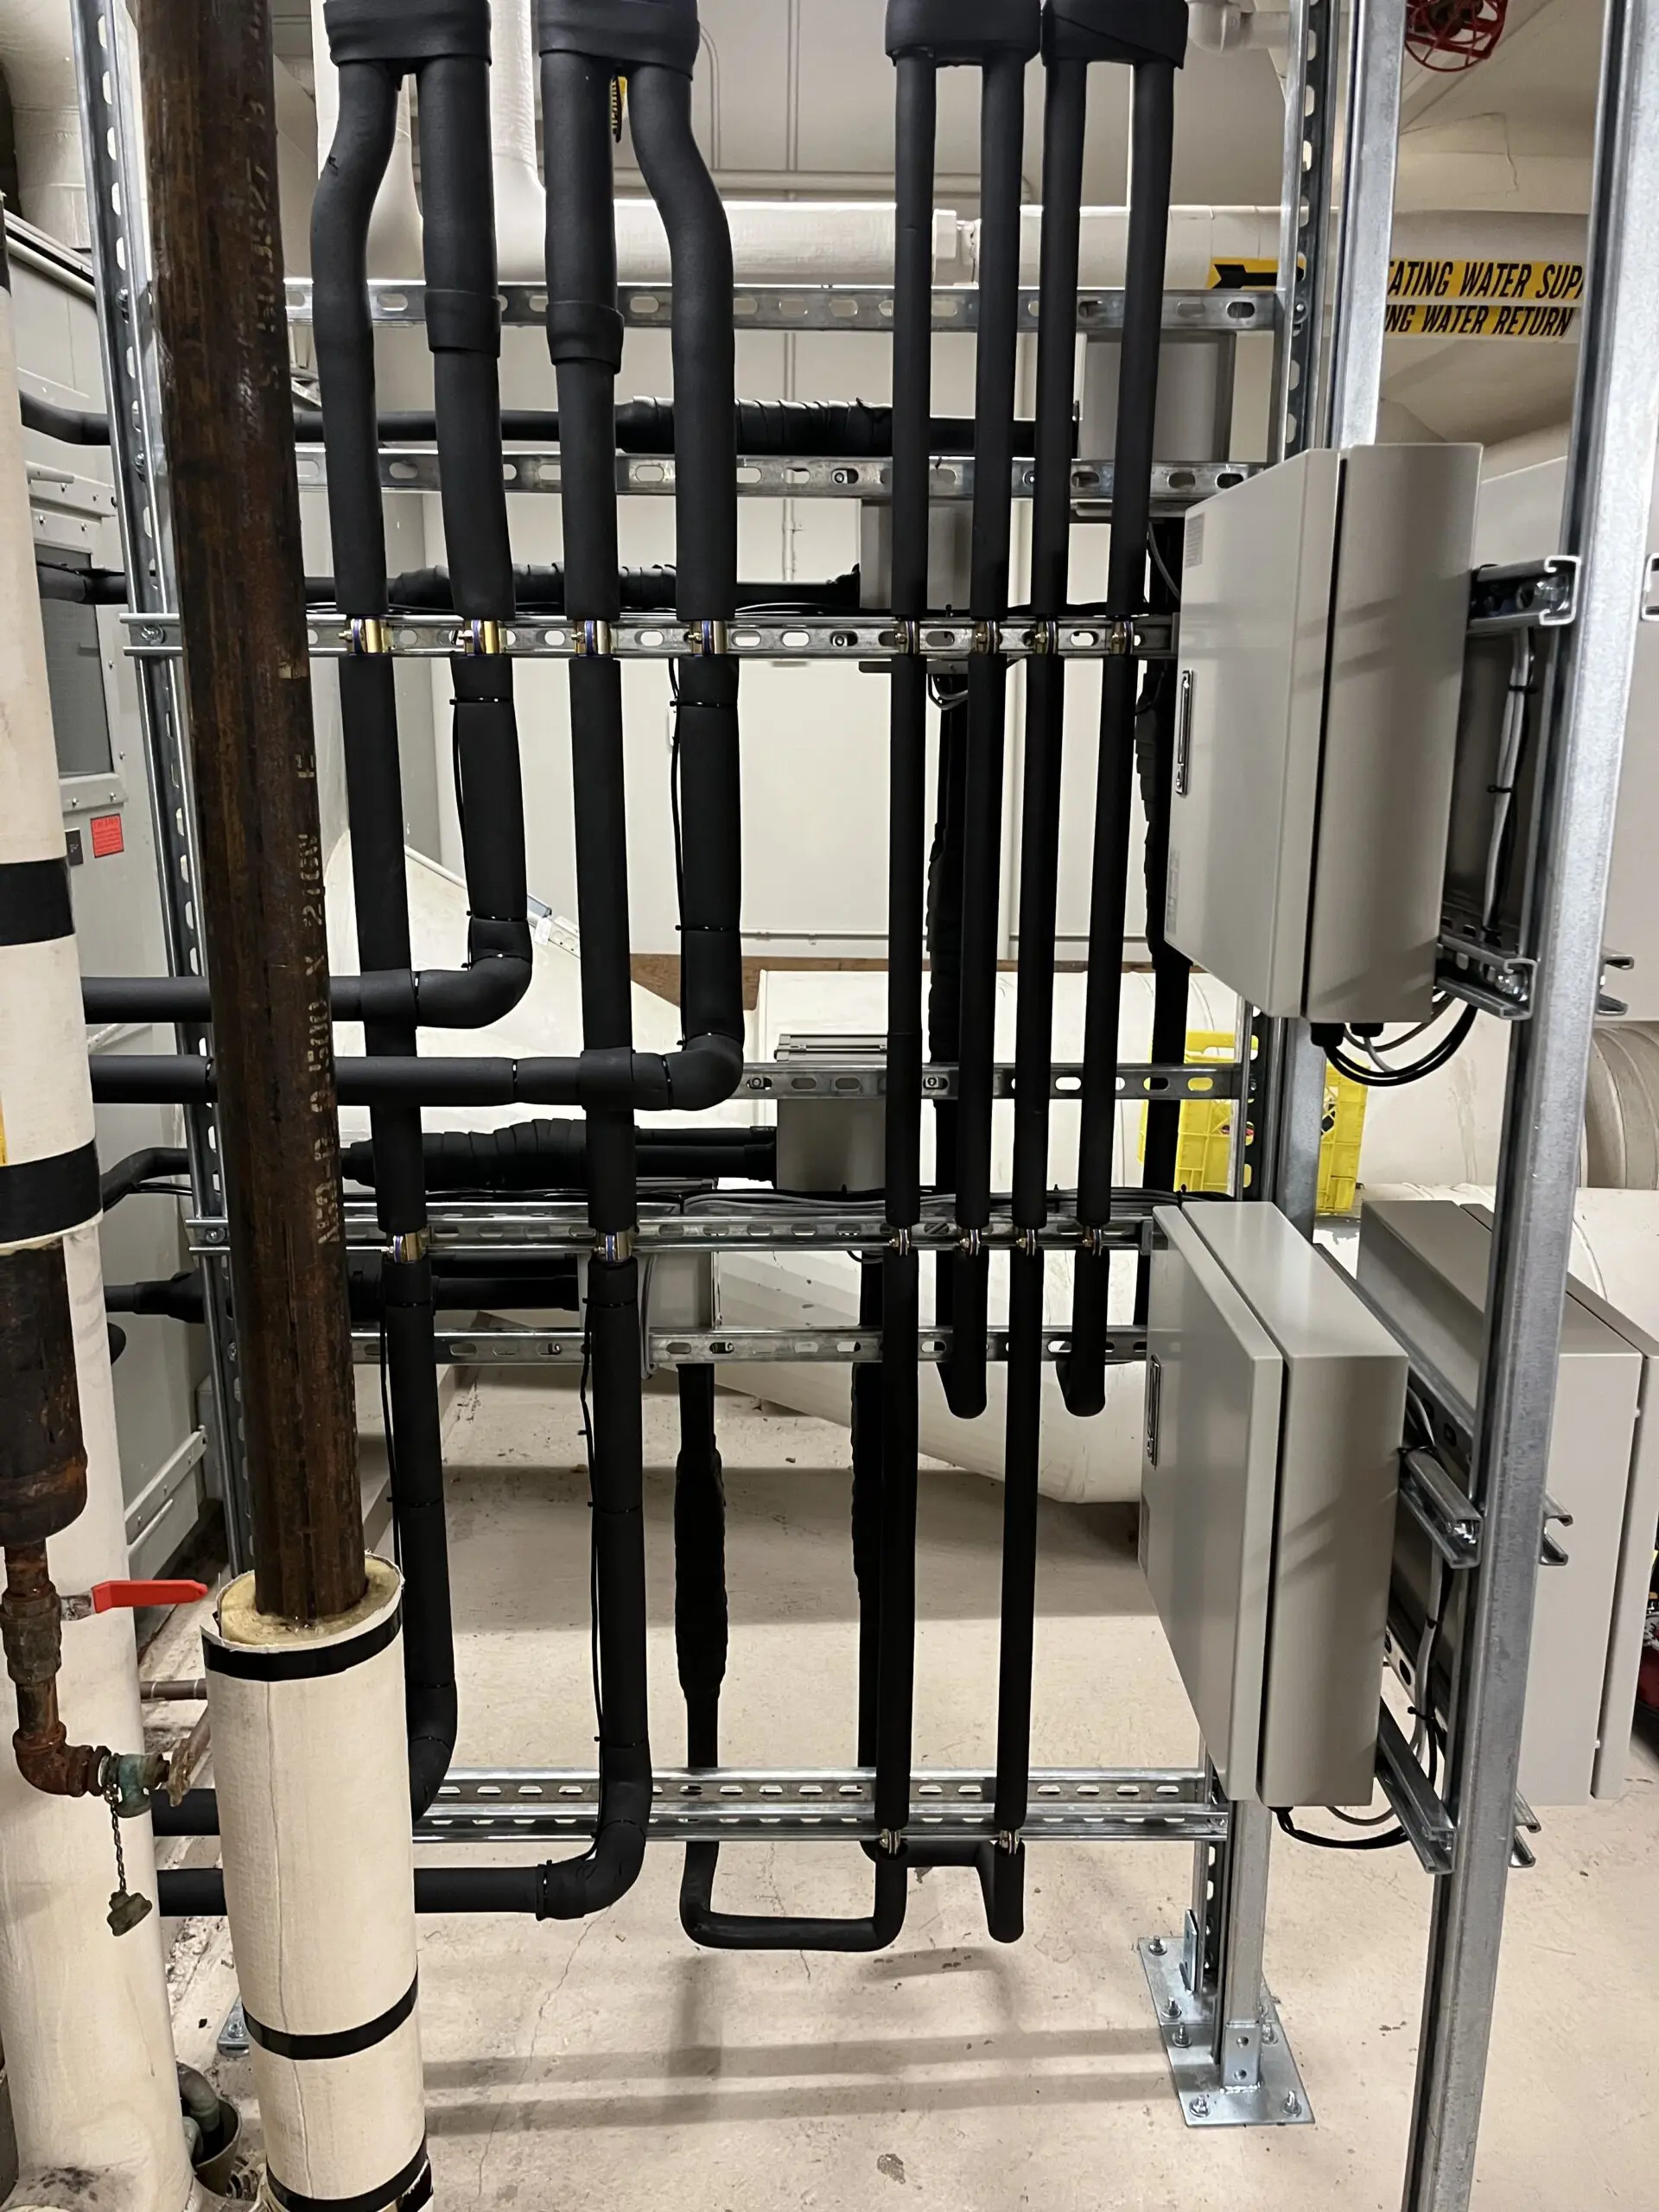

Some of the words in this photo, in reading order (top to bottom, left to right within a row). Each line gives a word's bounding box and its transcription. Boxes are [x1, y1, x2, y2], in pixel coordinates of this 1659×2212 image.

[1388, 262, 1453, 296] ATING
[1459, 262, 1532, 297] WATER
[1421, 305, 1490, 334] WATER
[1491, 306, 1573, 336] RETURN
